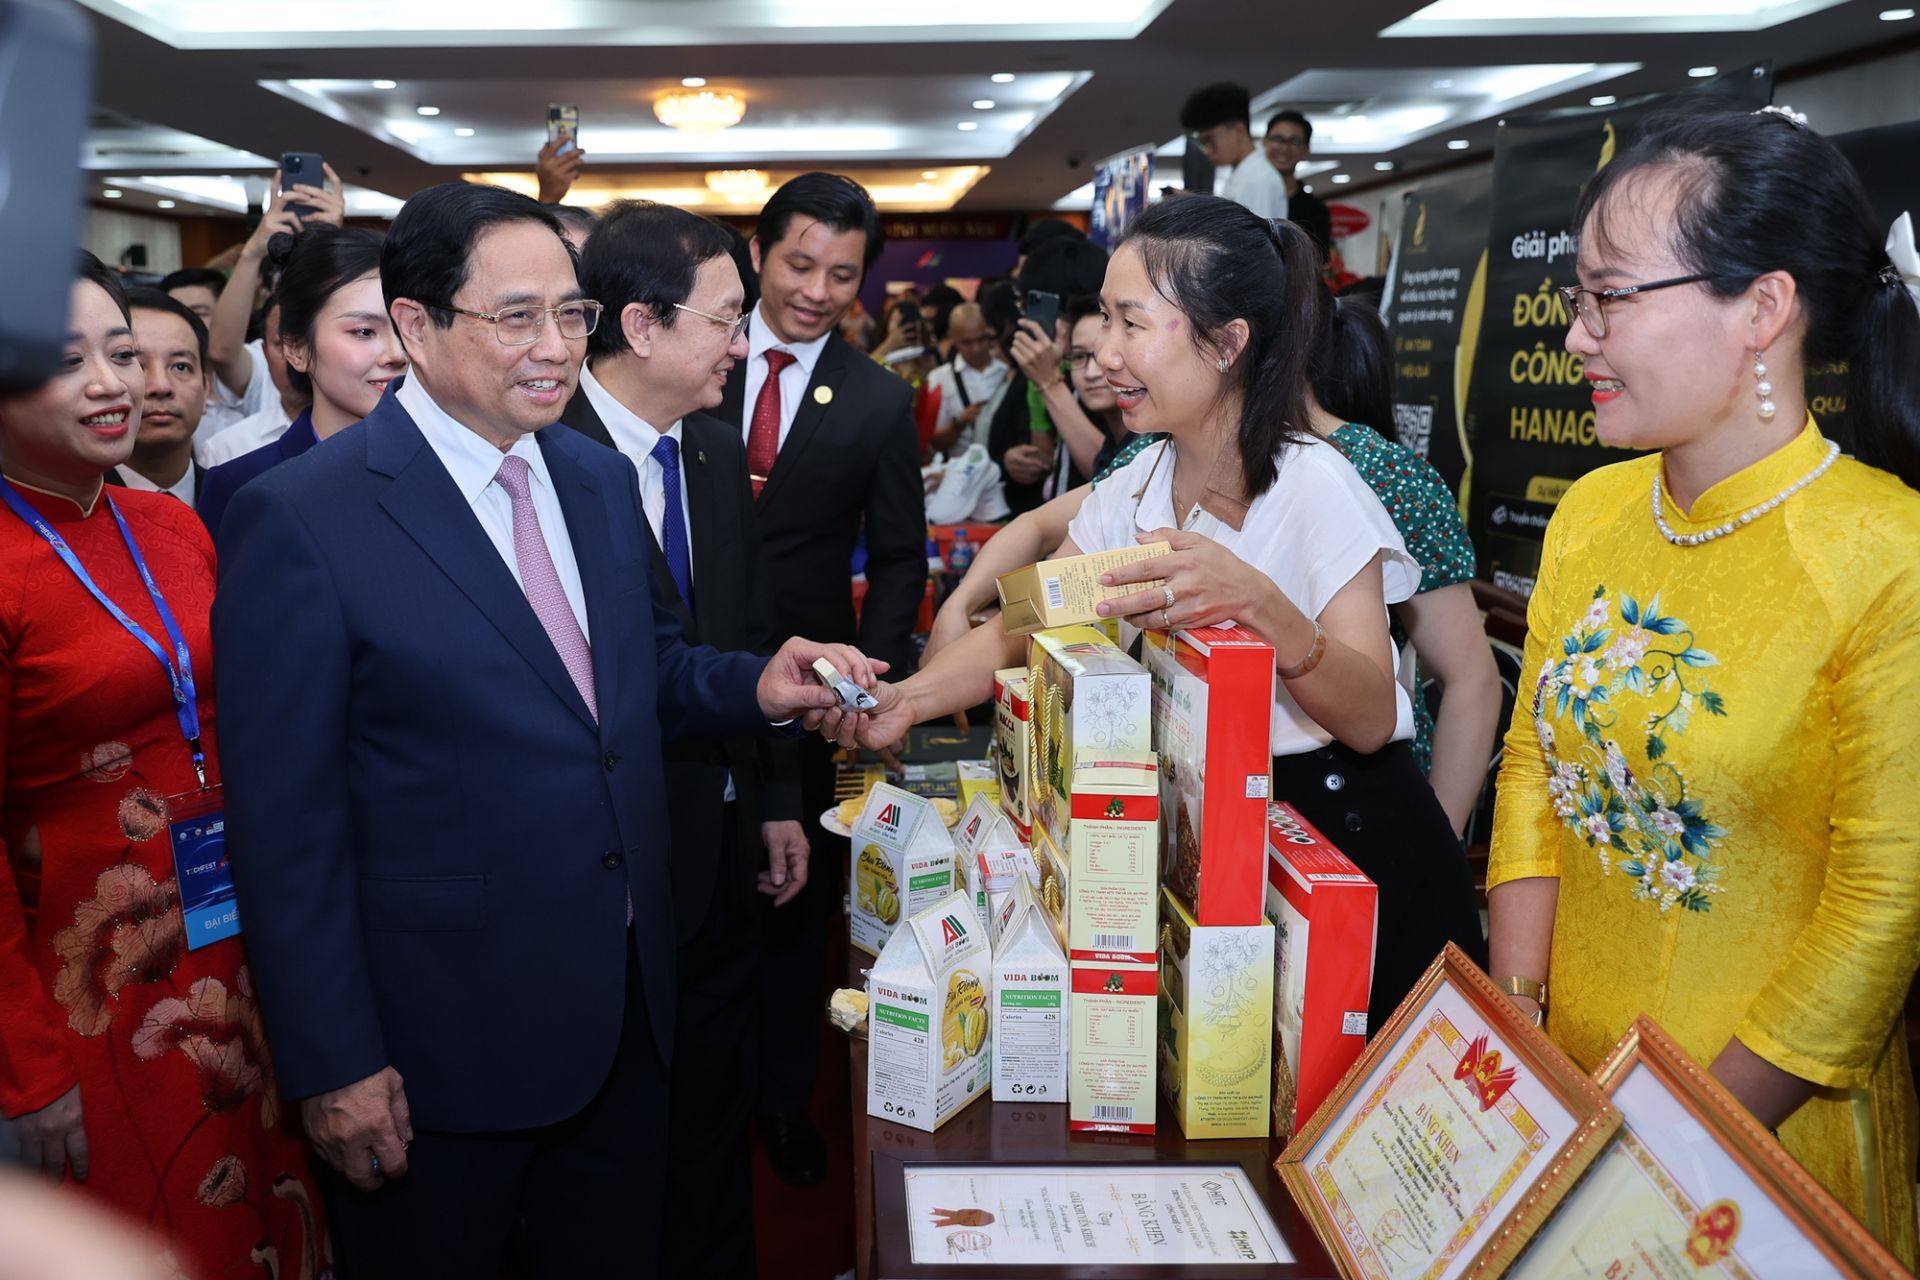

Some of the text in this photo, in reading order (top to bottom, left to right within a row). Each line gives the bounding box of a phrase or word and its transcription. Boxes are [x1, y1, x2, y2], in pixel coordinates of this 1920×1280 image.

[1511, 230, 1546, 259] Giải
[1510, 341, 1585, 385] CÔNG
[911, 862, 929, 871] VIDA
[1003, 974, 1027, 982] VIDA
[878, 987, 898, 999] VIDA
[880, 1008, 926, 1024] NUTRITION FACTS
[876, 1028, 925, 1045] Calories 428
[1435, 1129, 1462, 1165] KHEN
[1141, 1216, 1168, 1246] KHEN
[1236, 1238, 1257, 1260] HHTP
